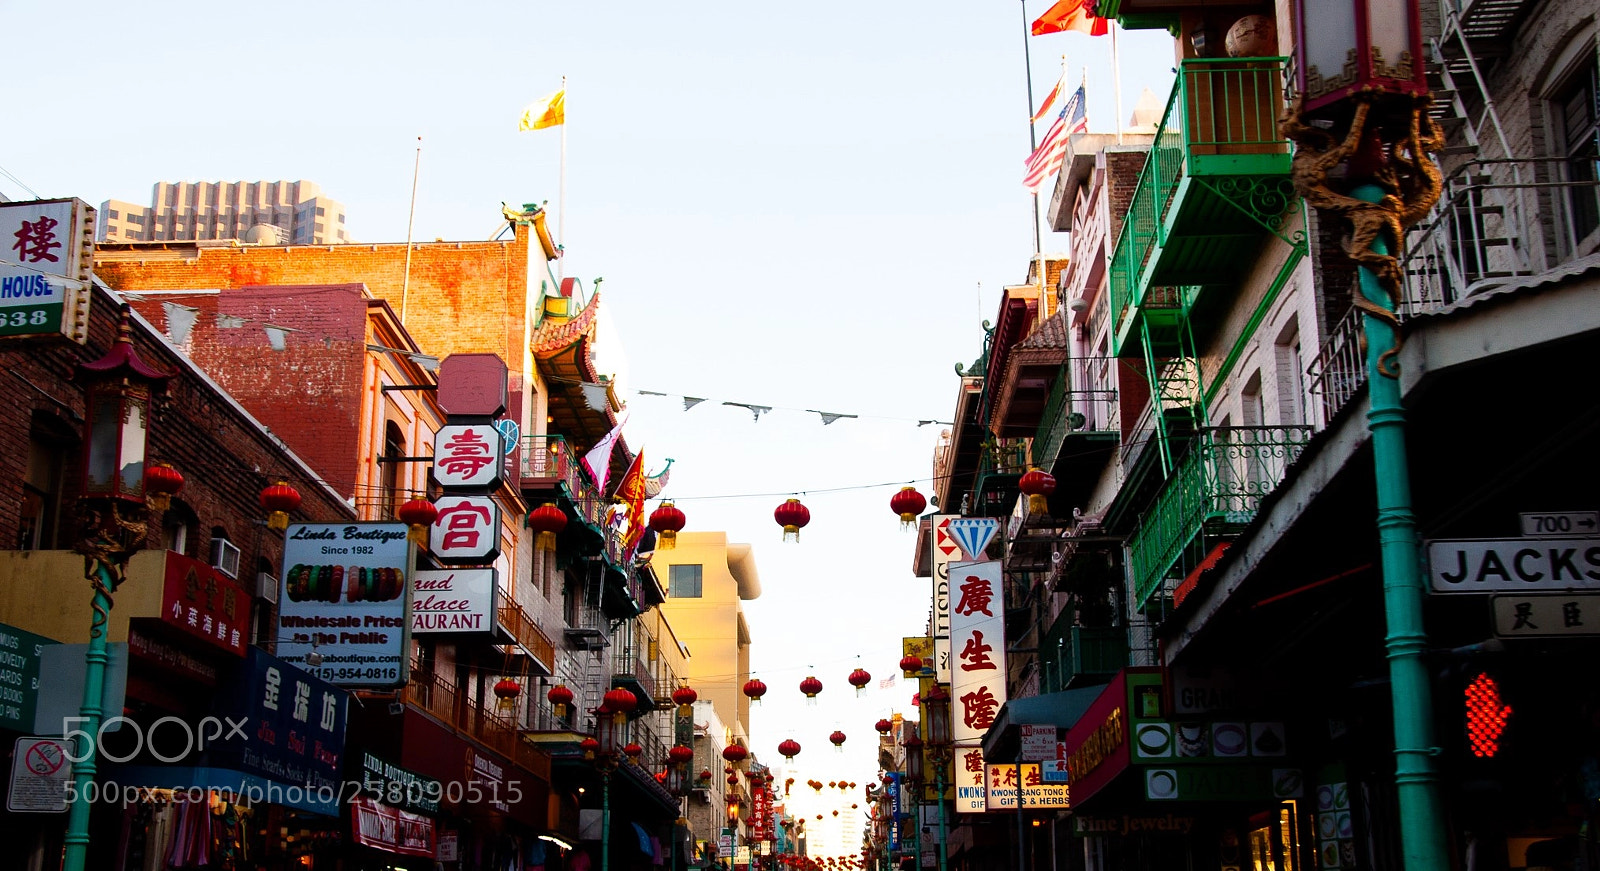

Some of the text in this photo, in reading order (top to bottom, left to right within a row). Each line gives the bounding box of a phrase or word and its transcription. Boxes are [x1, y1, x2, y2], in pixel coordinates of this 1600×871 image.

[13, 215, 61, 262] 樓
[2, 274, 53, 298] HOUSE
[1531, 516, 1571, 532] 700
[290, 526, 406, 544] Linda Boutique
[321, 546, 374, 555] Since 1982
[1440, 548, 1600, 584] JACKS
[280, 615, 404, 628] Wholesale Price
[293, 632, 310, 645] to
[340, 632, 388, 645] Public
[955, 575, 999, 730] 廣生隆
[1021, 725, 1032, 736] NO
[958, 786, 984, 799] KWONG
[1021, 788, 1041, 797] SANG
[1043, 788, 1064, 797] TONG
[1030, 797, 1036, 805] &
[1039, 797, 1070, 806] HERBS
[1076, 816, 1118, 833] Fine
